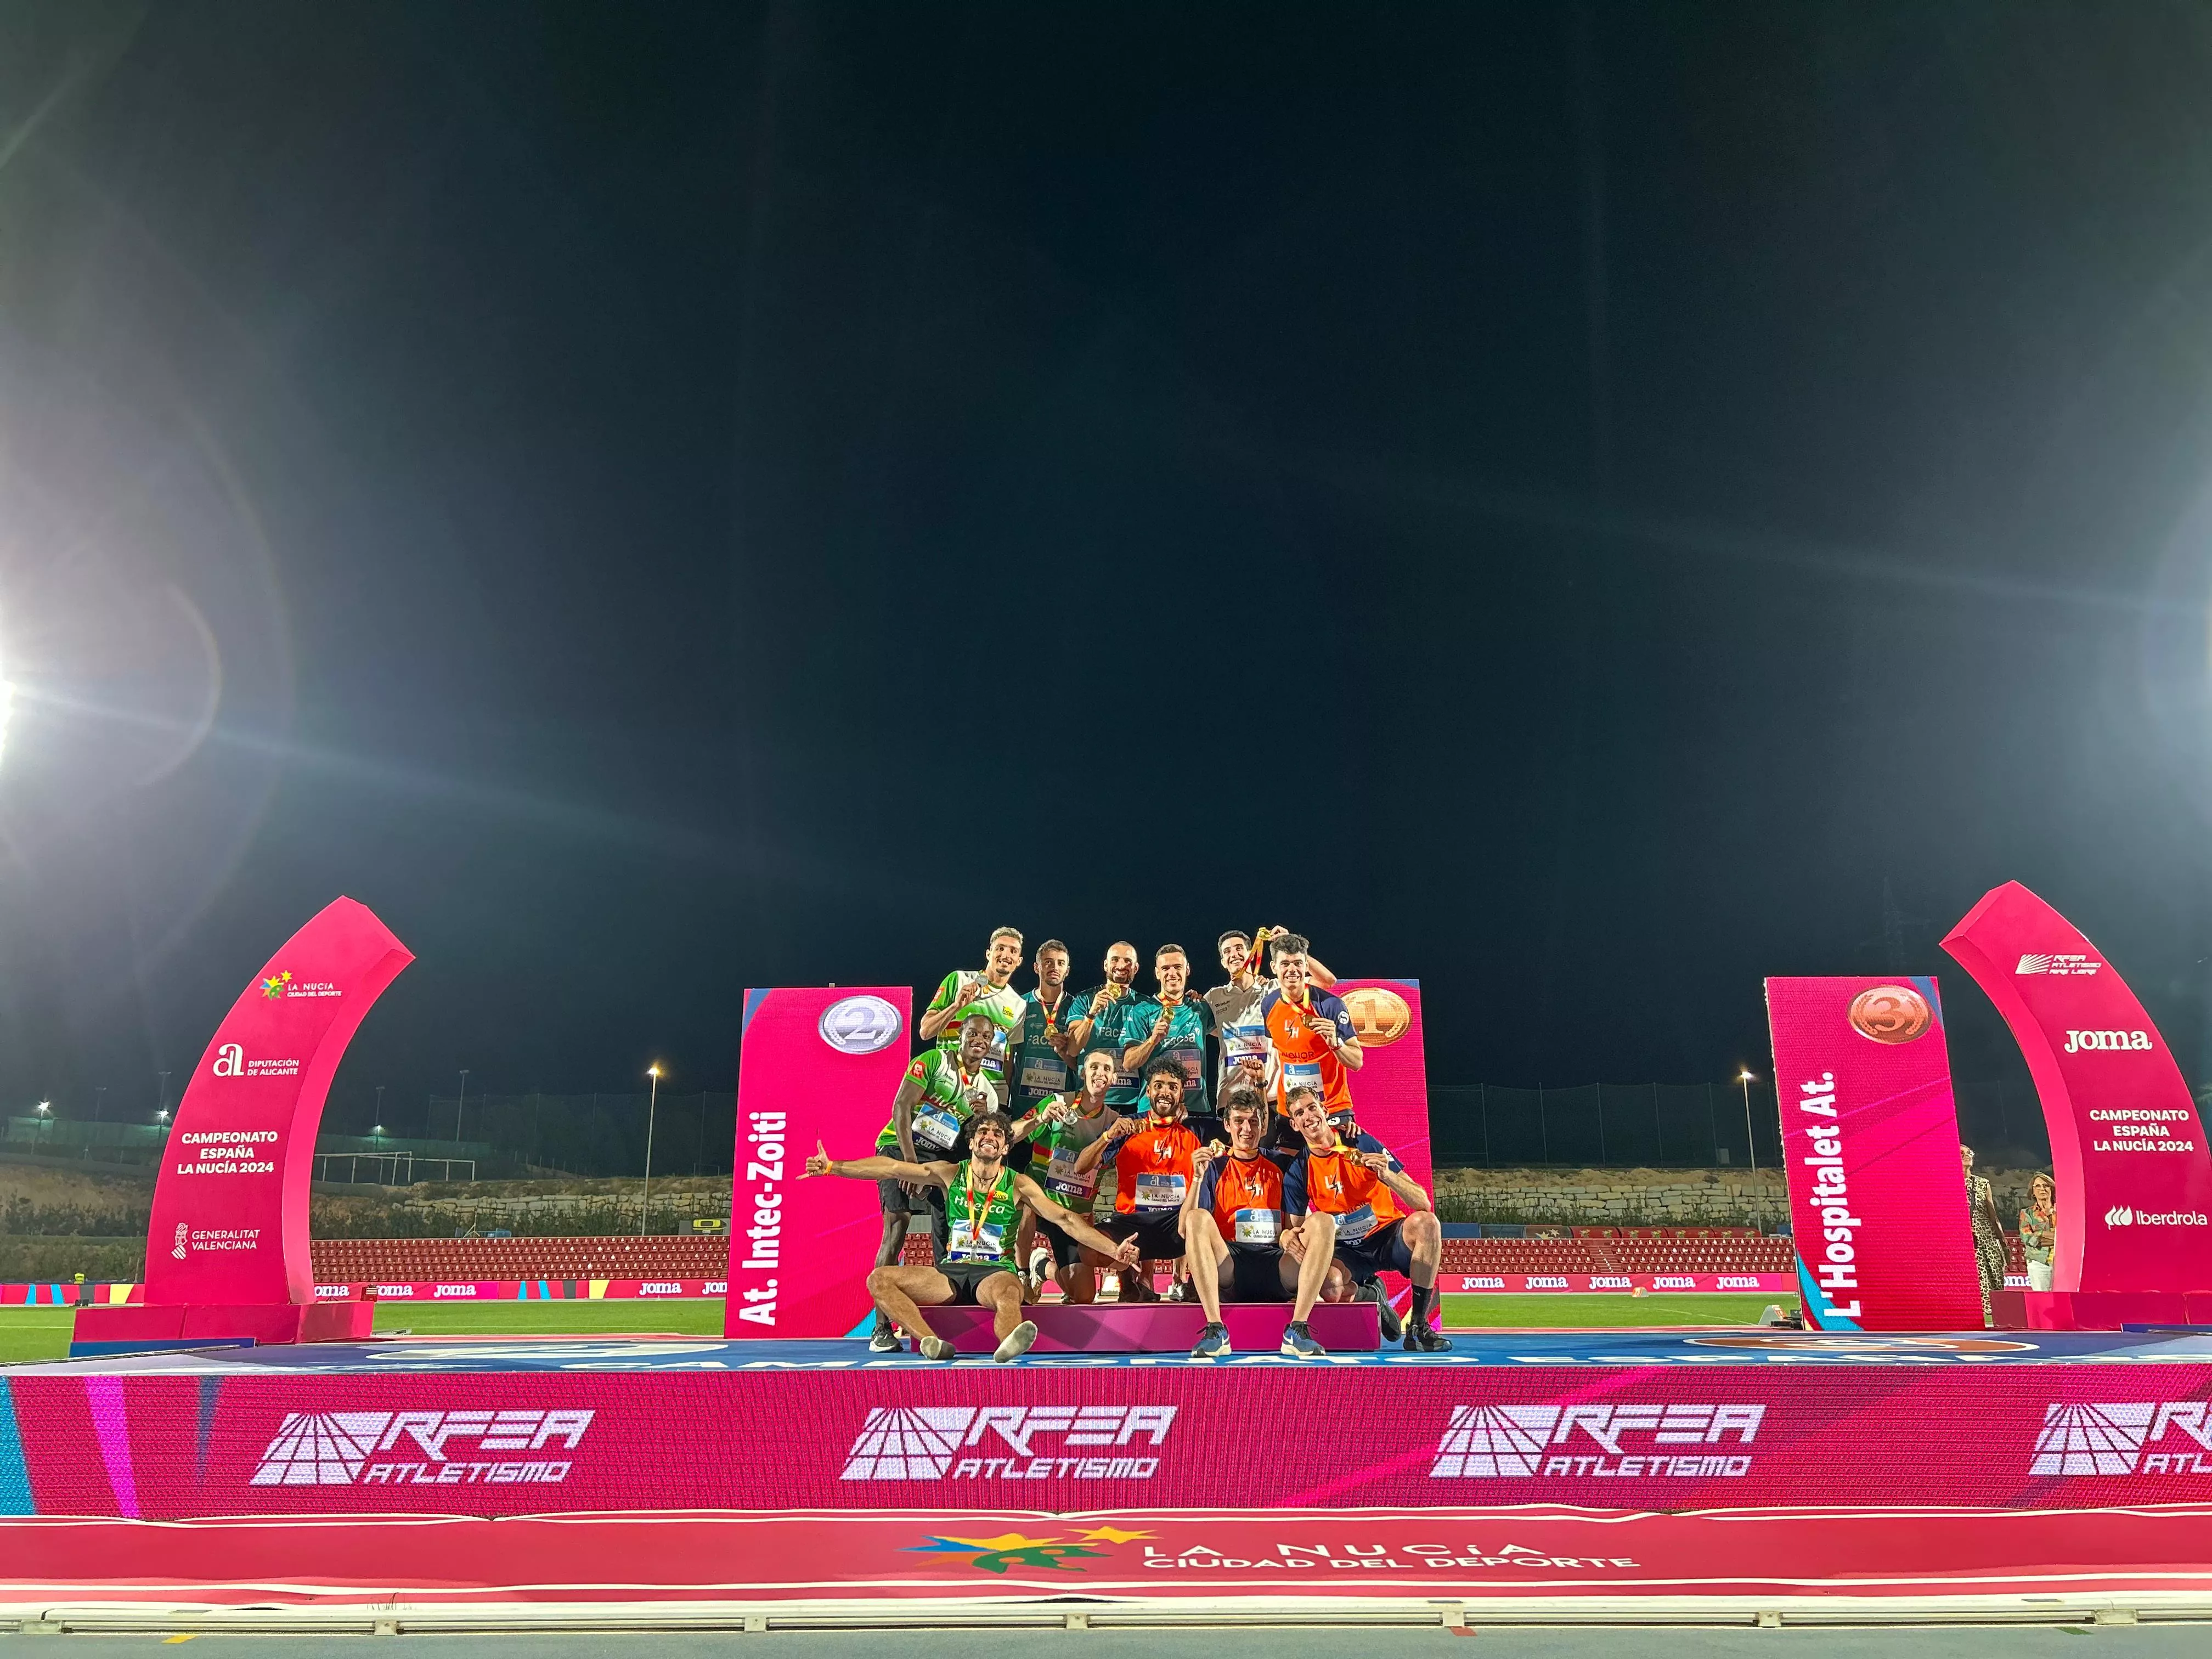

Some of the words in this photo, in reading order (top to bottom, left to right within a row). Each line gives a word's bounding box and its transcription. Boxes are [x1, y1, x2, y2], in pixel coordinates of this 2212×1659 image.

[2053, 955, 2086, 963] RFEA
[843, 999, 879, 1040] 2
[1356, 998, 1385, 1034] 1
[249, 1058, 300, 1067] DIPUTACIÓN
[980, 1058, 996, 1068] ma
[1800, 1071, 1837, 1118] At.
[2089, 1109, 2190, 1121] CAMPEONATO
[2113, 1122, 2170, 1137] ESPAÑA
[181, 1131, 278, 1144] CAMPEONATO
[2094, 1140, 2112, 1152] LA
[2113, 1138, 2157, 1152] NUCÍA
[2158, 1140, 2194, 1152] 2024
[200, 1144, 255, 1160] ESPAÑA
[177, 1163, 194, 1175] LA
[195, 1160, 238, 1174] NUCÍA
[239, 1161, 274, 1173] 2024
[741, 1111, 787, 1269] Intec-Zoiti
[1804, 1124, 1861, 1318] L'Hospitalet
[2136, 1210, 2208, 1226] Iberdrola
[192, 1229, 260, 1240] GENERALITAT
[191, 1240, 257, 1250] VALENCIANA
[314, 1284, 349, 1296] oma
[377, 1284, 414, 1296] oma
[738, 1280, 777, 1327] At.
[377, 1409, 596, 1460] RFEA
[964, 1406, 1179, 1457] RFEA
[1550, 1403, 1767, 1455] RFEA
[363, 1461, 573, 1485] ATLETISMO
[952, 1457, 1159, 1480] ATLETISMO
[1543, 1455, 1753, 1477] ATLETISMO
[1144, 1544, 1224, 1558] LA
[1143, 1558, 1316, 1569] CIUDAD
[1329, 1559, 1414, 1569] DEL
[1426, 1556, 1642, 1568] DEPORTE
